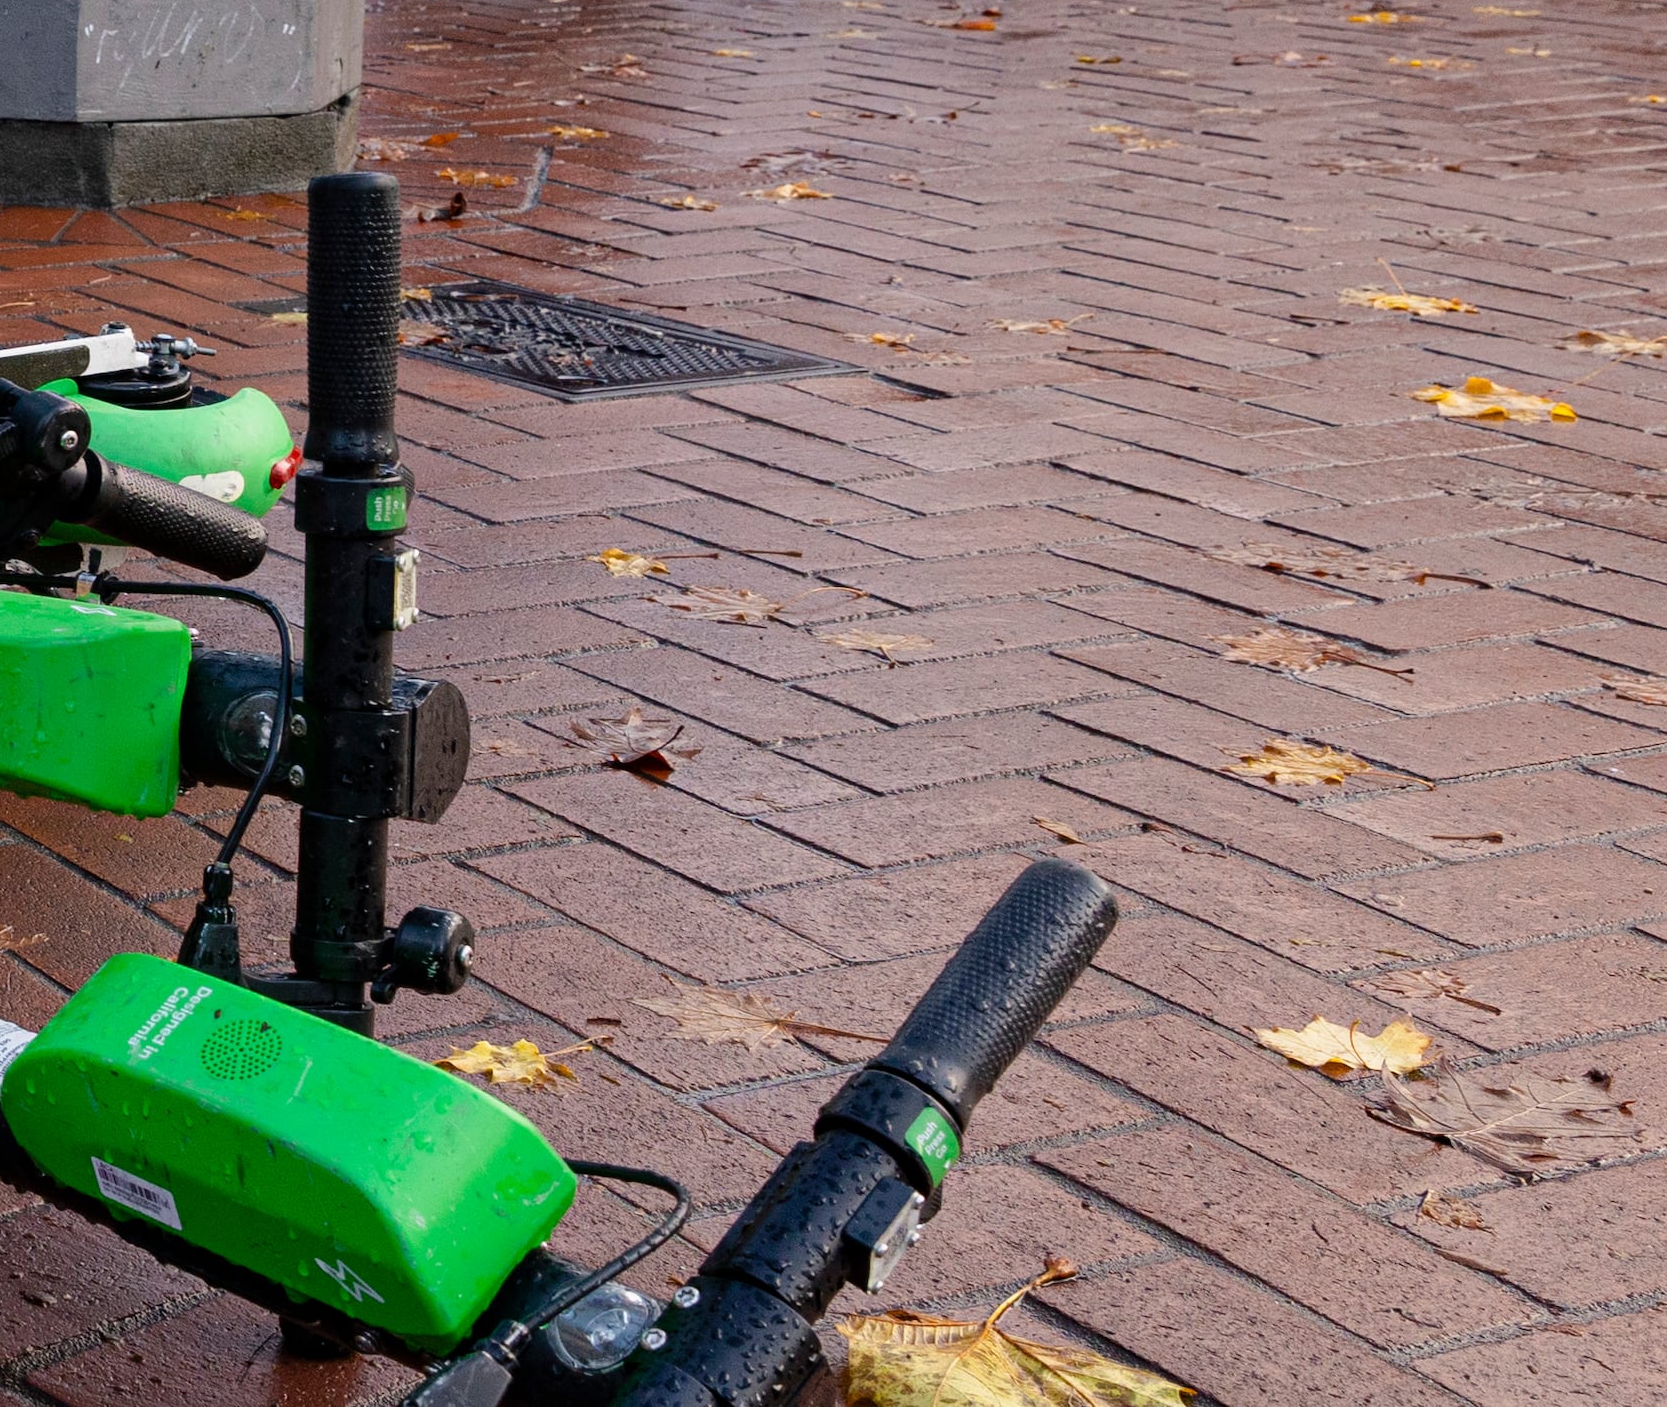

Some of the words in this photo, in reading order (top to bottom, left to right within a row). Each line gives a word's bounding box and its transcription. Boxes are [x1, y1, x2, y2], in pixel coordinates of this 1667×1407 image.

[373, 496, 383, 522] Push
[384, 495, 392, 523] Press
[128, 987, 189, 1046] California
[152, 986, 213, 1046] Designed
[916, 1120, 937, 1146] Push
[925, 1131, 946, 1156] Press
